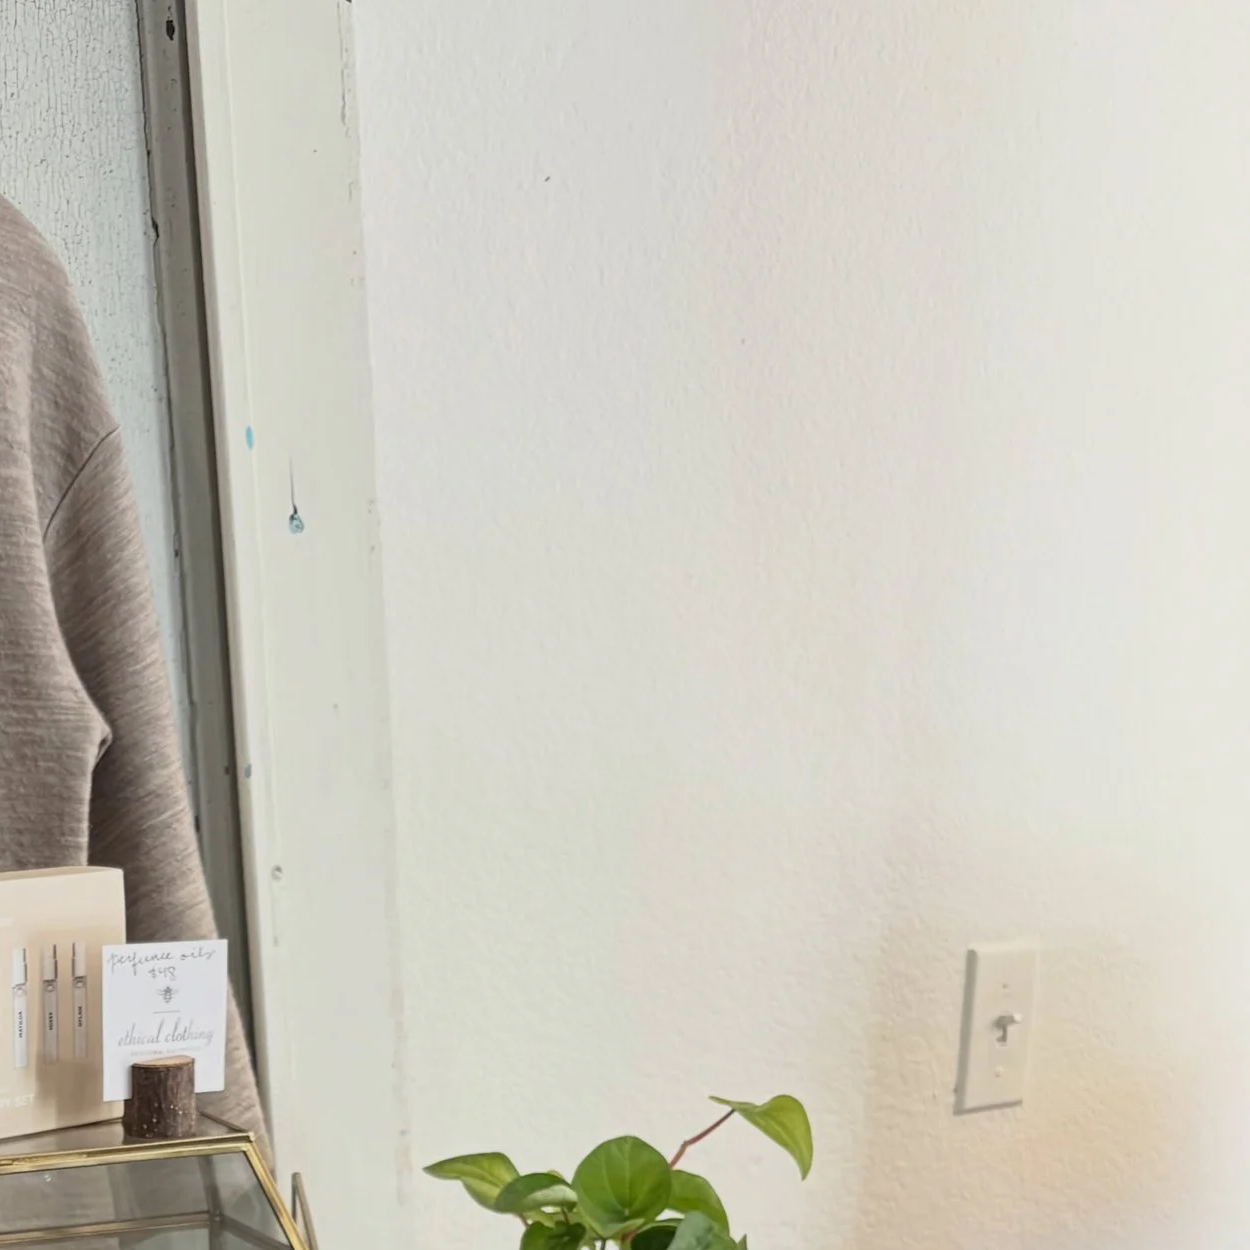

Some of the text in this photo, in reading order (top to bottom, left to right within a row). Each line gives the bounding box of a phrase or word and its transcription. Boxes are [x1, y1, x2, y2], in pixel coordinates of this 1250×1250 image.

[180, 947, 216, 960] oils
[118, 1017, 213, 1047] ethical clothing
